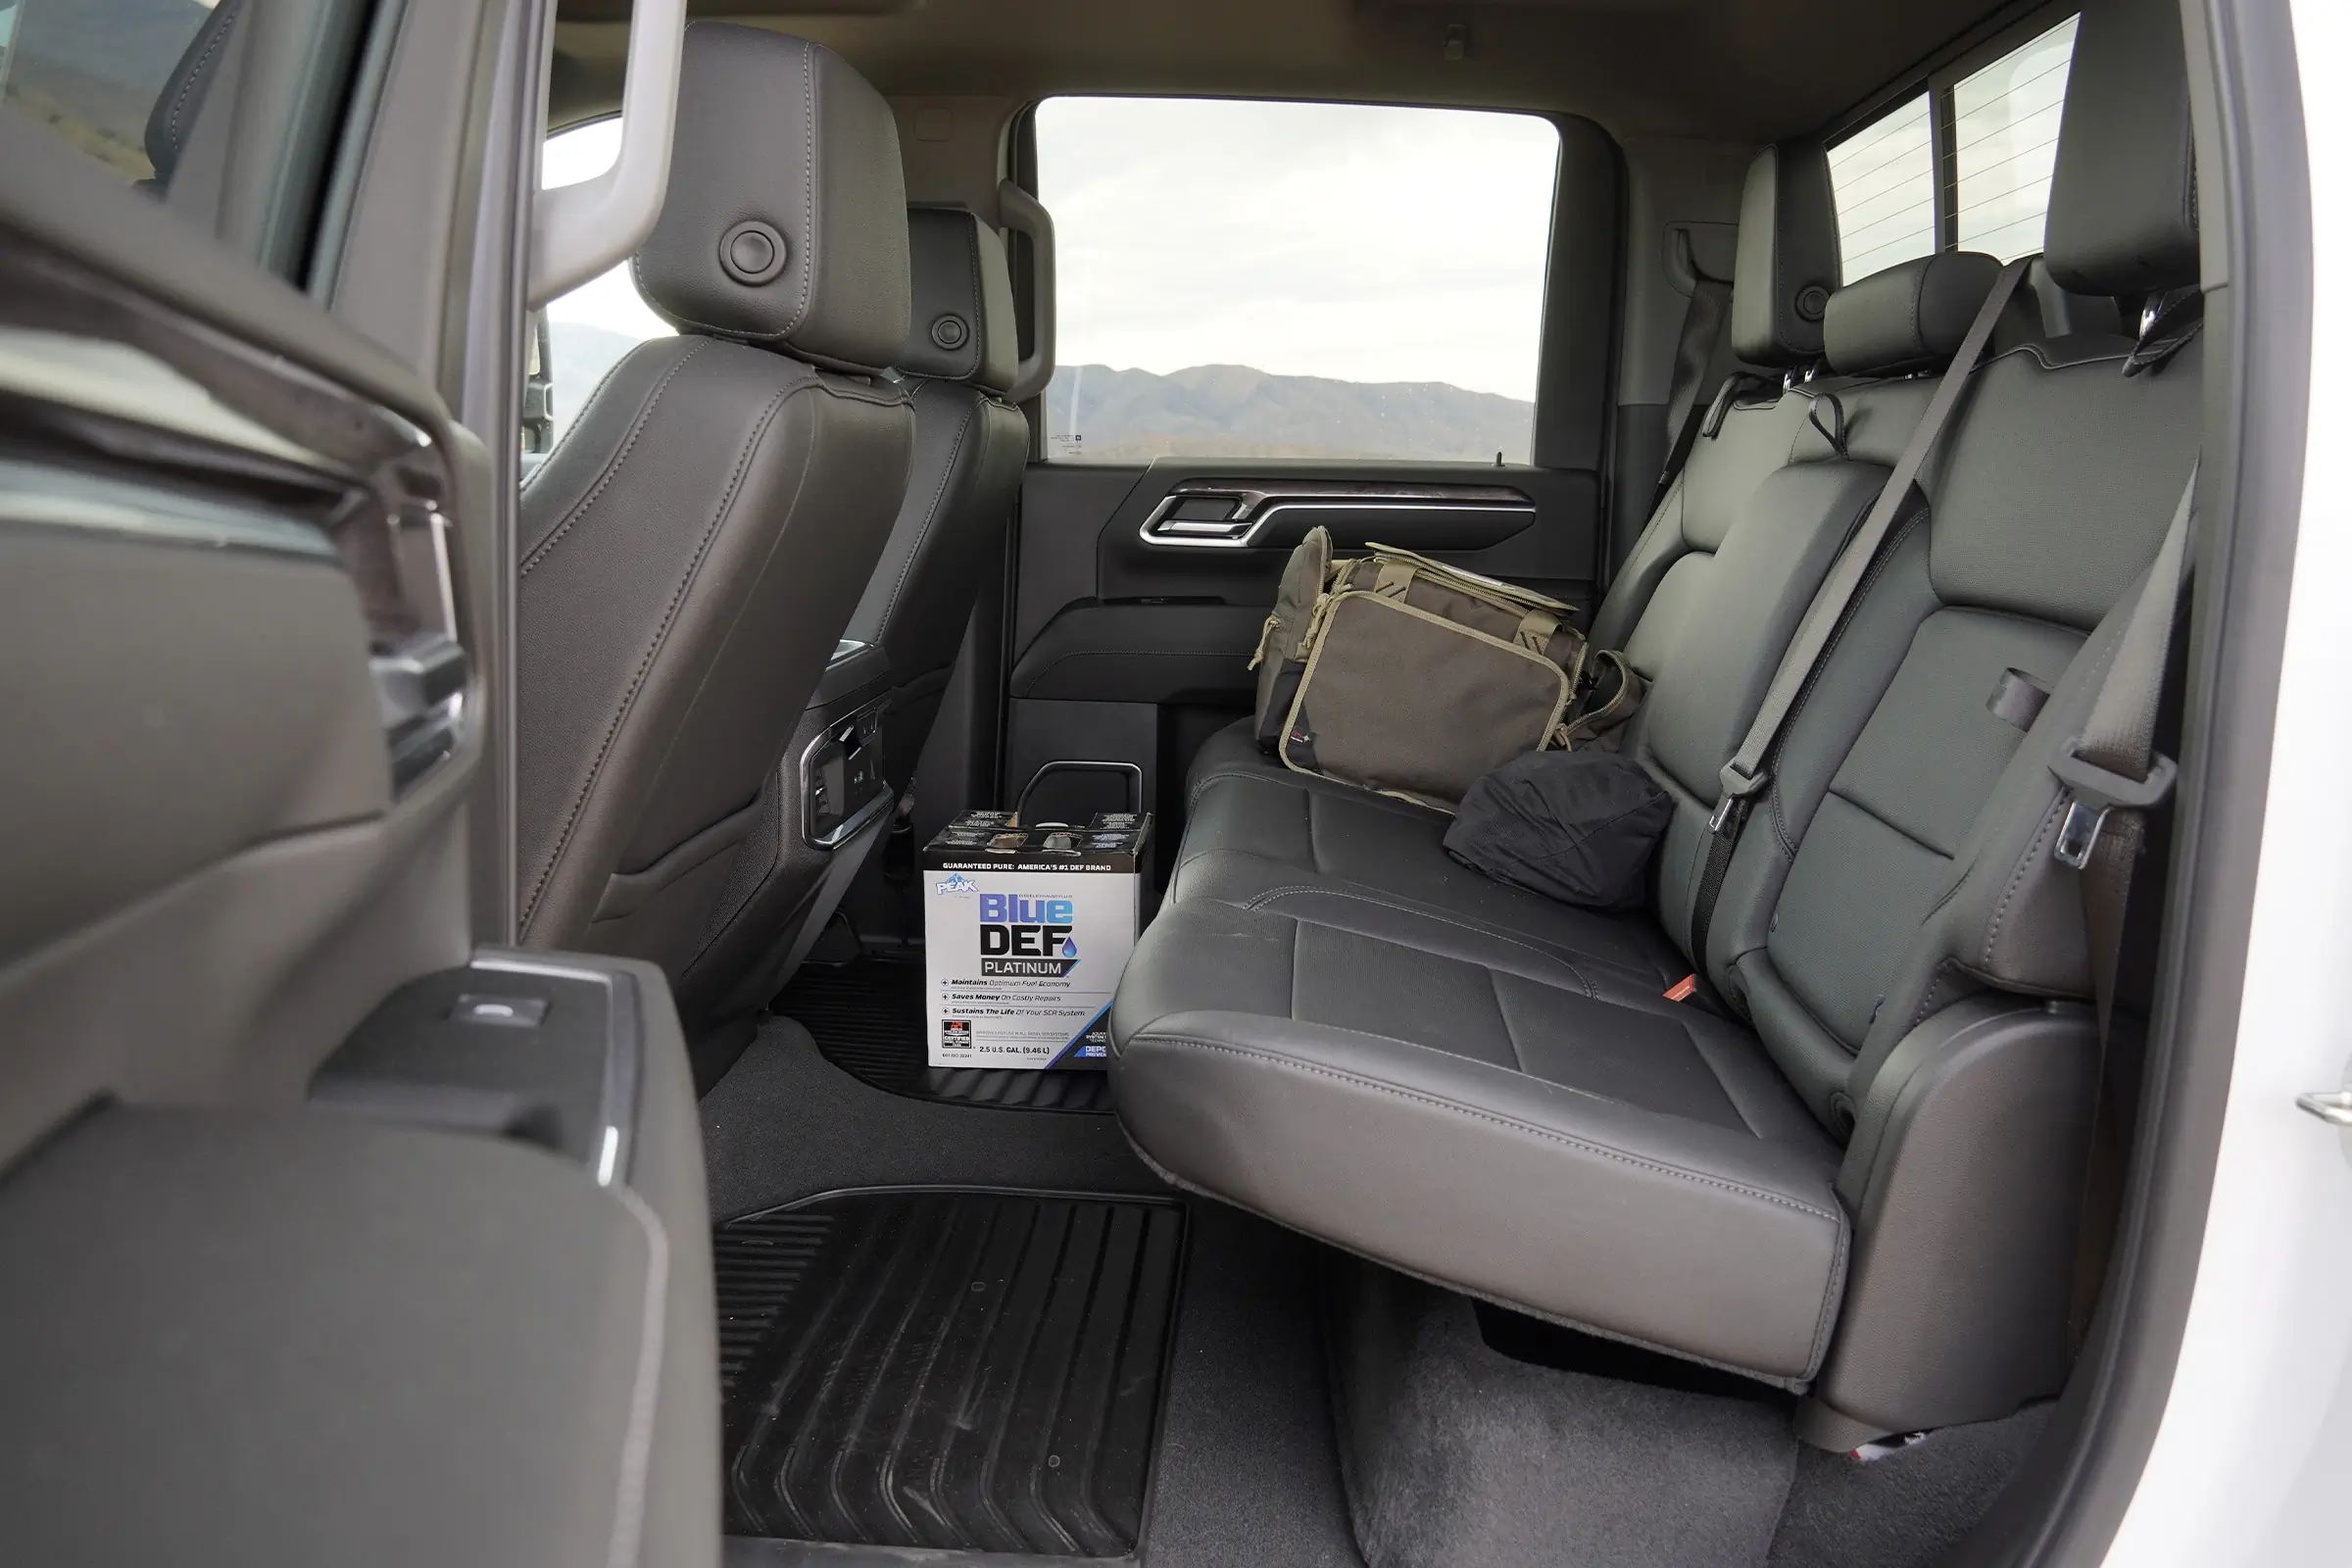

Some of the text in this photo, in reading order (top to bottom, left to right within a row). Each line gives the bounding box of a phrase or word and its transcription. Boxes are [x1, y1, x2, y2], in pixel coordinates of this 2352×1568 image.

[936, 879, 978, 895] PEAK
[980, 894, 1072, 923] Blue
[980, 924, 1073, 957] DEF
[985, 961, 1061, 974] PLATINUM
[1023, 1046, 1041, 1054] (9.46
[1043, 1046, 1050, 1054] L)
